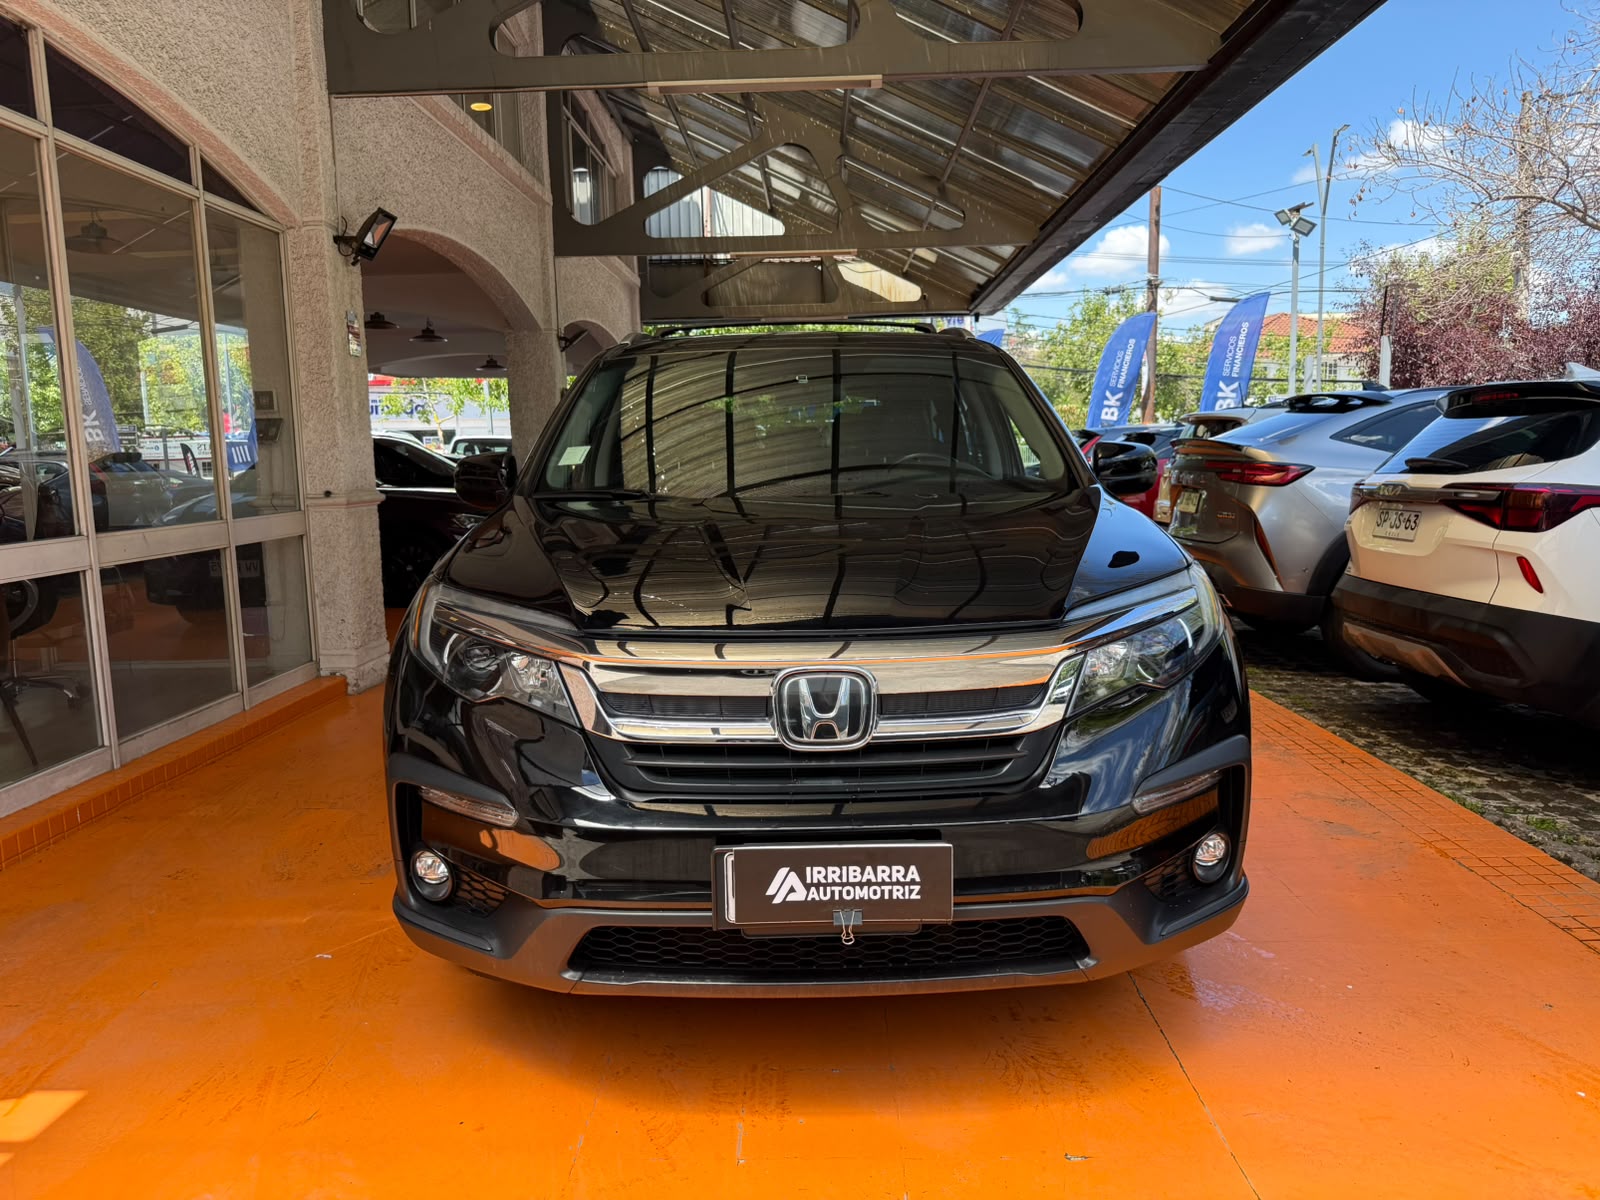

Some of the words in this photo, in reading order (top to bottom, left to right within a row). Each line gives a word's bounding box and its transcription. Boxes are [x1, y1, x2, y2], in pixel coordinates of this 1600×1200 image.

[1117, 338, 1136, 389] FINANCIEROS
[1222, 336, 1237, 377] SERVICIOS
[1231, 321, 1249, 378] FINANCIEROS
[1109, 350, 1124, 387] SERVICIOS
[1101, 390, 1124, 421] BK
[1215, 380, 1240, 411] BK
[805, 865, 921, 883] IRRIBARRA
[807, 885, 921, 901] AUTOMOTRIZ
